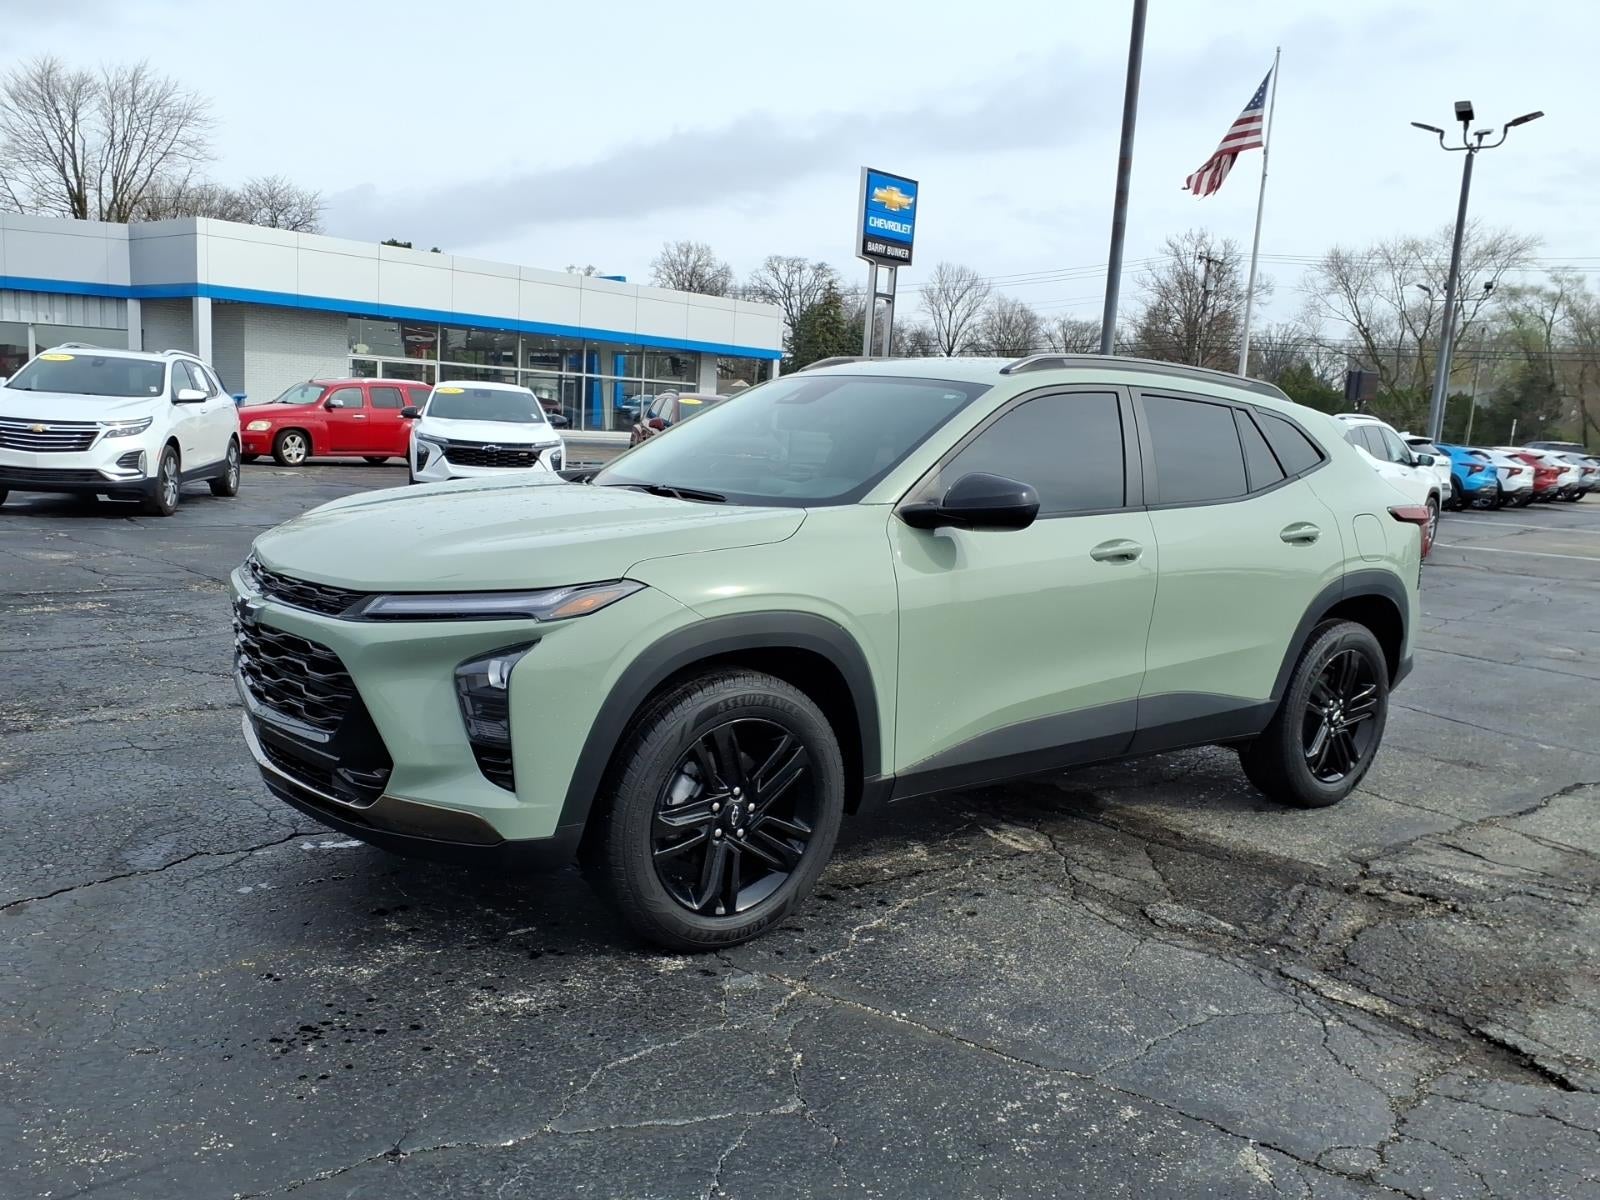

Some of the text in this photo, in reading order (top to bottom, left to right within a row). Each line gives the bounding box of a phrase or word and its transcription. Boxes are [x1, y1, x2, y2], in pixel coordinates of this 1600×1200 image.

[869, 216, 912, 234] CHEVROLET
[867, 241, 909, 258] BARRY BUNKER
[717, 694, 800, 717] ASSURANCE
